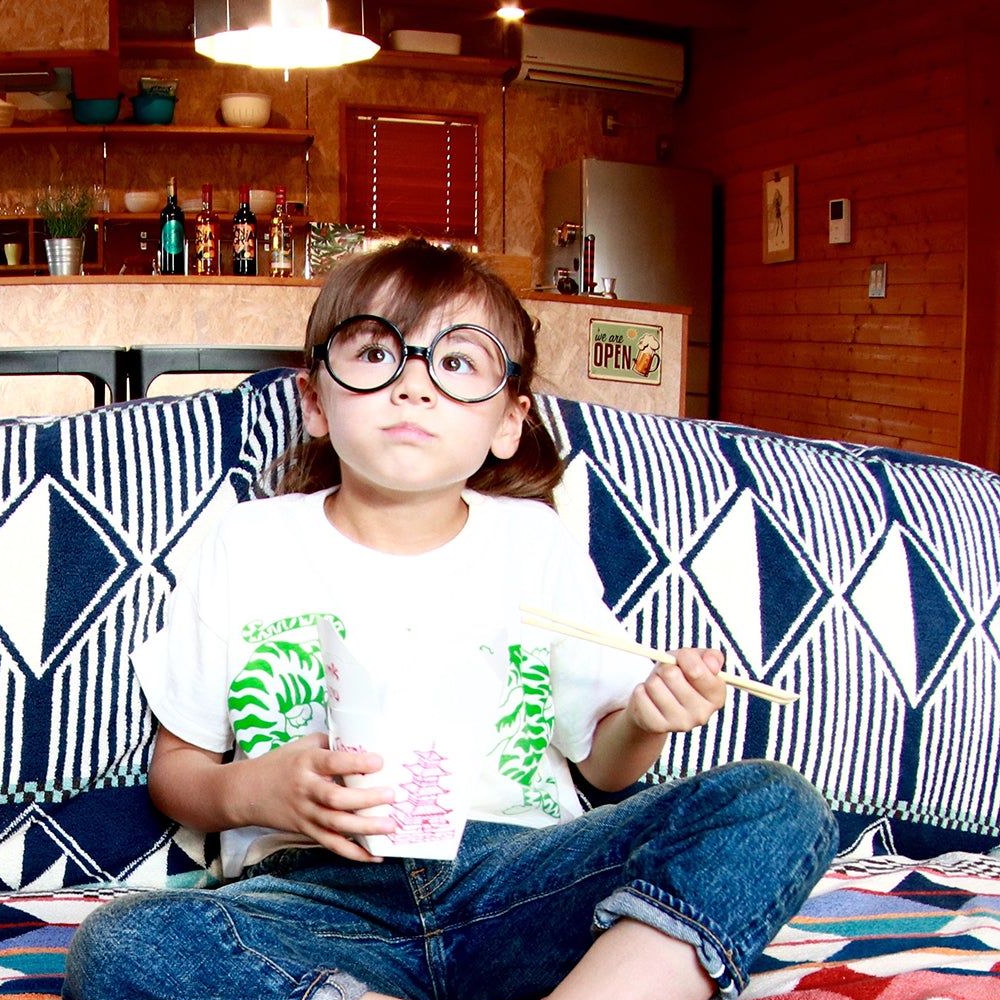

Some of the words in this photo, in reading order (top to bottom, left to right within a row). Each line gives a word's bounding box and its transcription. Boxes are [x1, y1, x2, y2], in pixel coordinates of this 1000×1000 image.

[595, 333, 607, 343] we
[608, 335, 624, 343] are
[593, 342, 632, 370] OPEN
